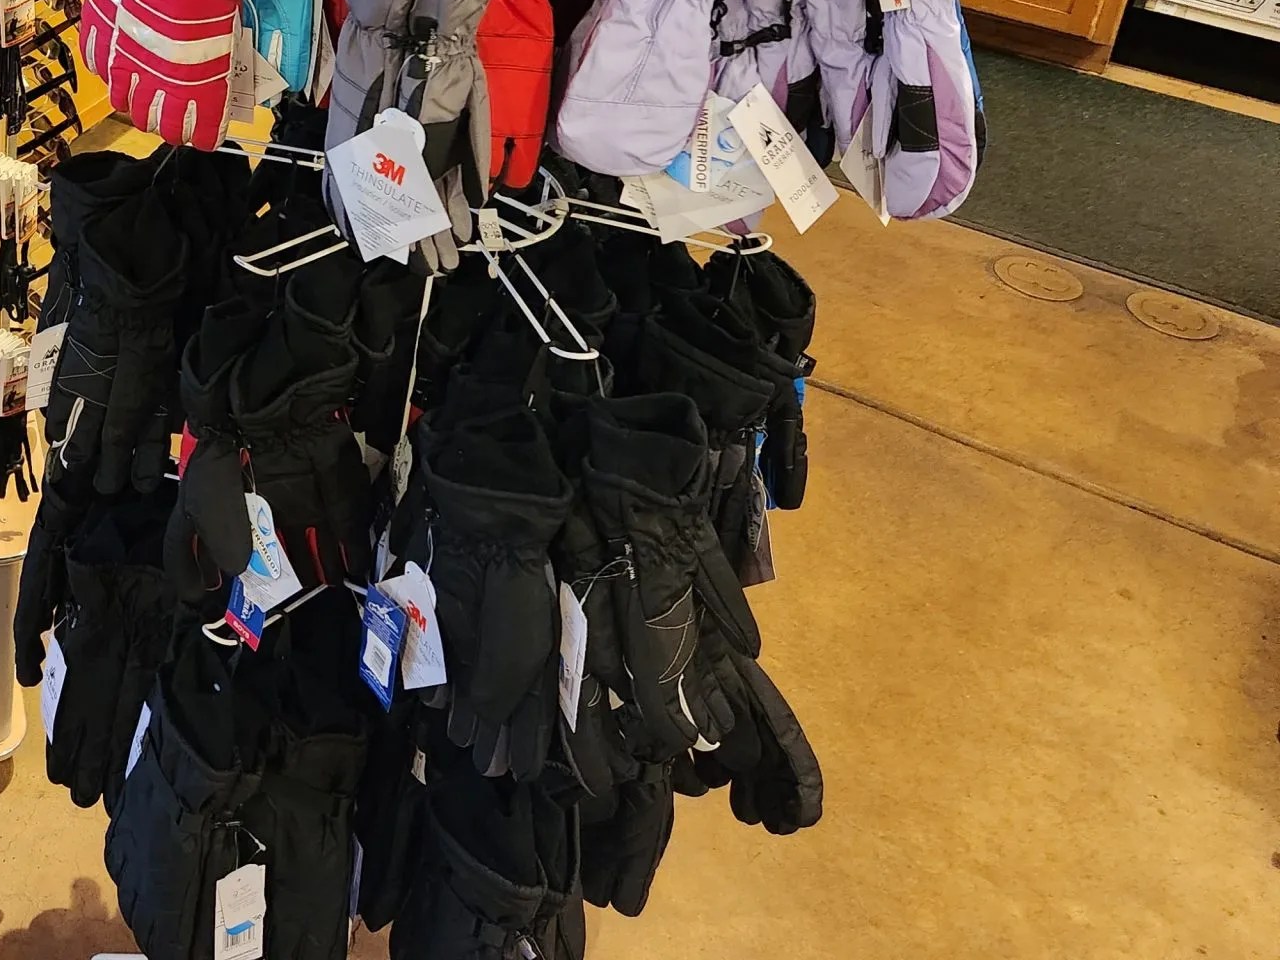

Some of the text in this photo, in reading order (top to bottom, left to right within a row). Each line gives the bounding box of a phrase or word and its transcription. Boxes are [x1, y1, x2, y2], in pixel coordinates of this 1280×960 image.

[695, 108, 710, 190] WATERPROOF
[761, 131, 795, 166] GRAND
[372, 152, 406, 187] 3M
[350, 161, 424, 215] THINSULATE
[789, 174, 819, 204] TODDLER
[33, 358, 56, 370] GRA
[407, 599, 427, 635] 3M
